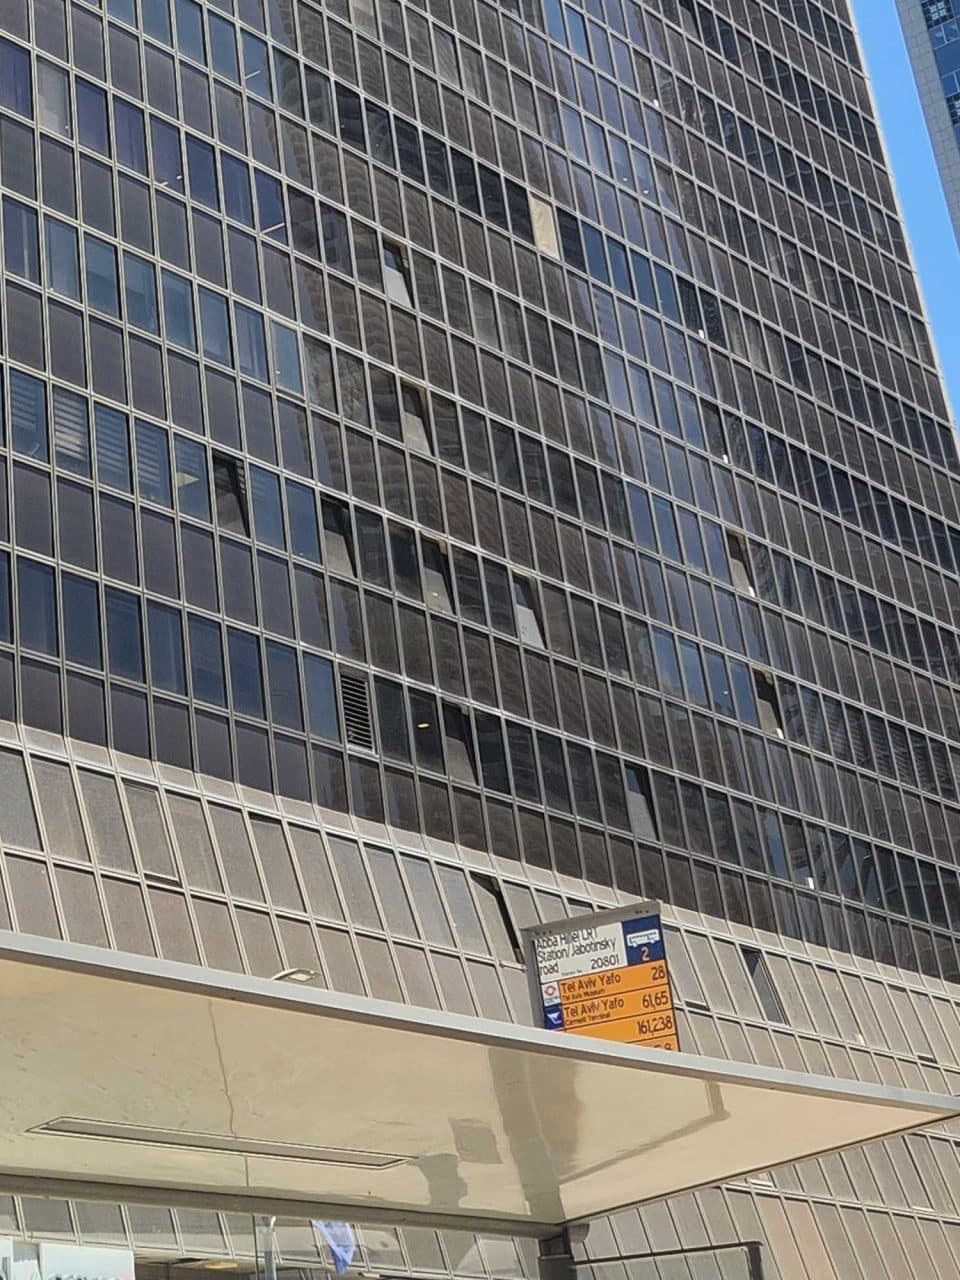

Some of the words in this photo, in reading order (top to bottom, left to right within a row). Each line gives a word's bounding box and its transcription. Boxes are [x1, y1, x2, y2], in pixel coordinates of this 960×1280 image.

[641, 946, 650, 961] 2
[539, 961, 559, 976] road
[591, 954, 620, 970] 20801
[561, 981, 575, 995] Tel
[578, 977, 598, 990] Aviv
[598, 973, 621, 986] Yafo
[651, 965, 666, 981] 28
[564, 1005, 579, 1018] Tel
[581, 1001, 600, 1015] Aviv
[603, 997, 625, 1012] Yafo
